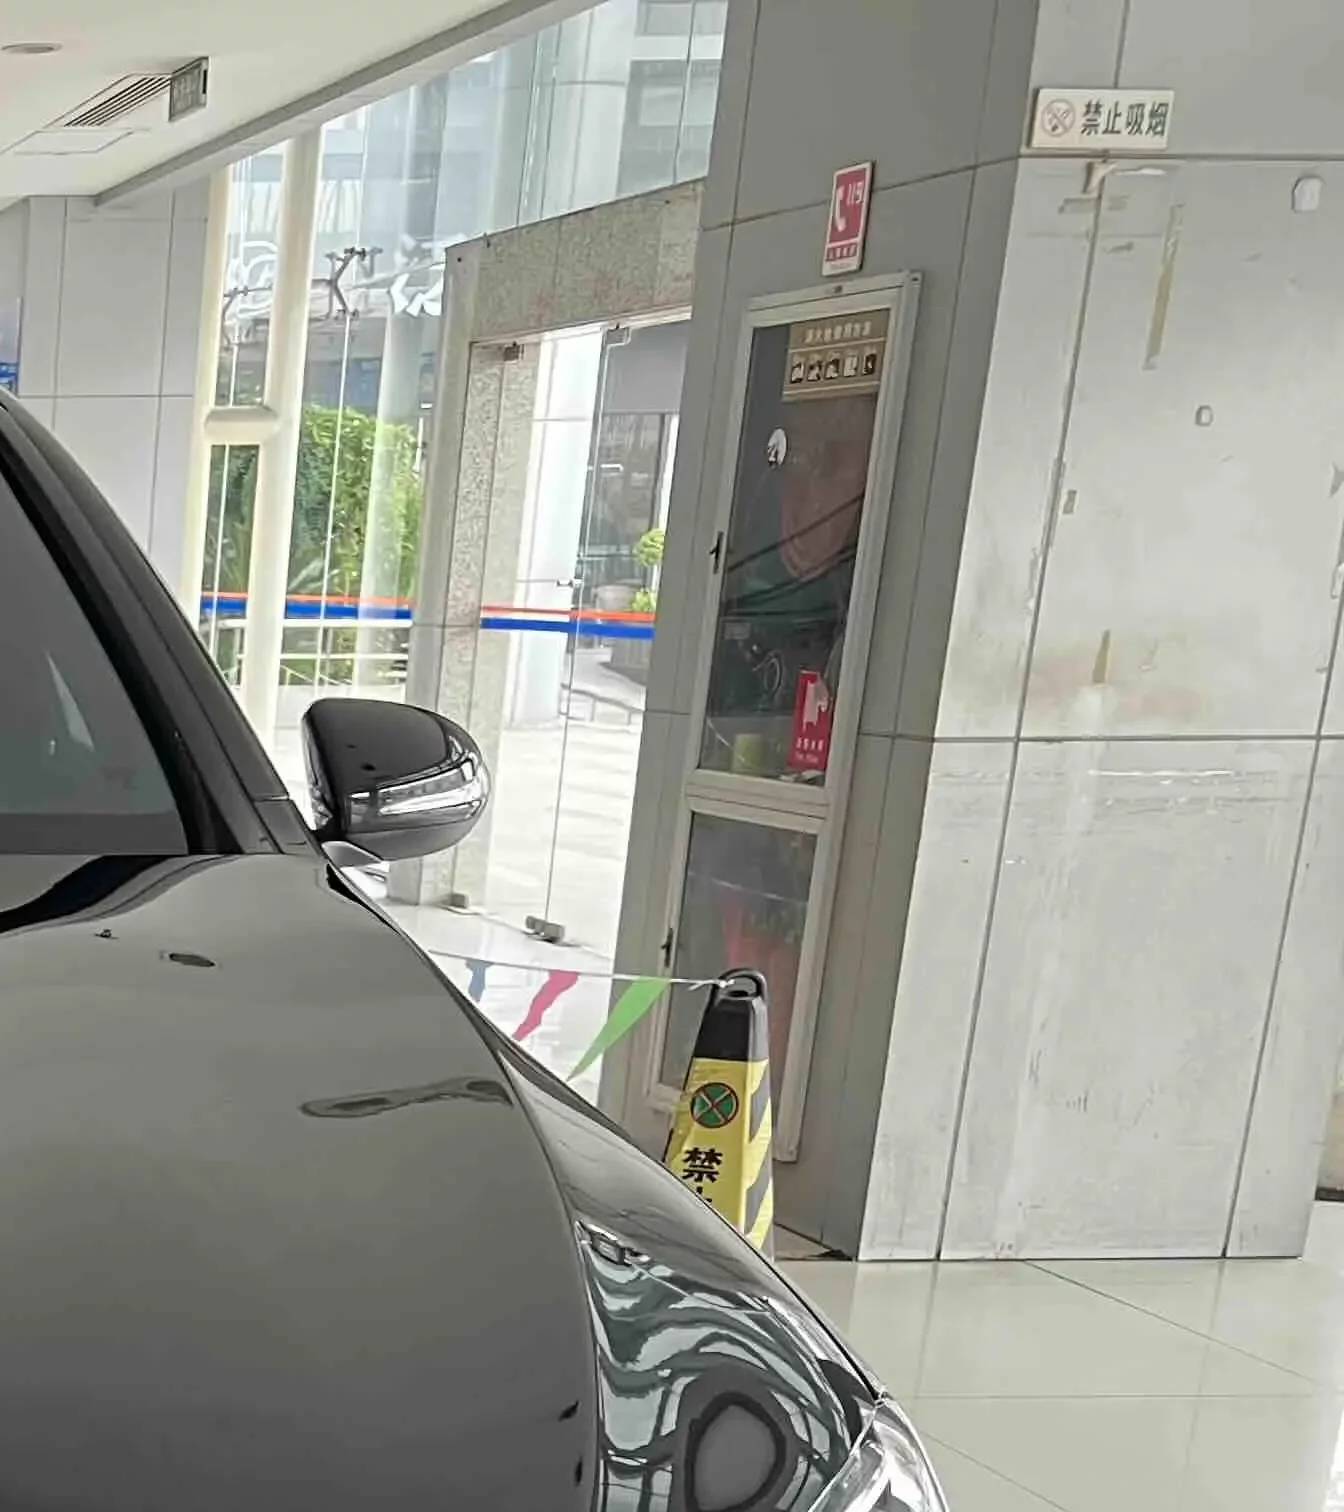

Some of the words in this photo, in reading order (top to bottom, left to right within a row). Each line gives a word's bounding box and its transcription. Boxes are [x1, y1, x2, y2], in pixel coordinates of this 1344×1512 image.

[1080, 99, 1169, 136] 禁止吸烟
[846, 181, 864, 206] 119
